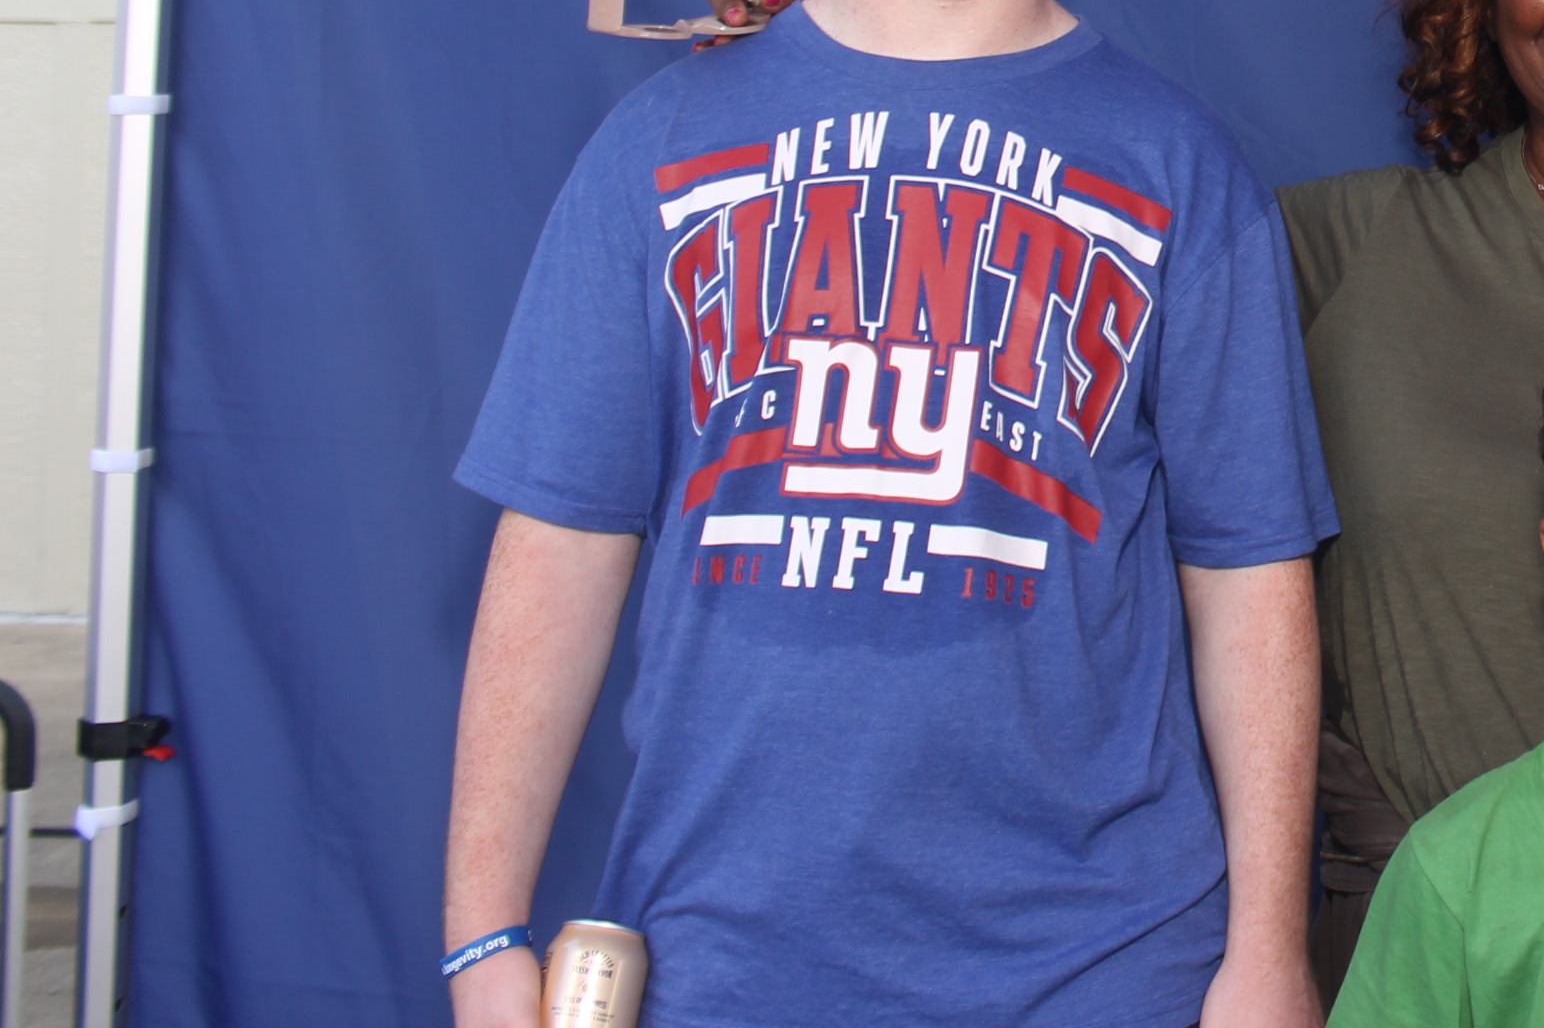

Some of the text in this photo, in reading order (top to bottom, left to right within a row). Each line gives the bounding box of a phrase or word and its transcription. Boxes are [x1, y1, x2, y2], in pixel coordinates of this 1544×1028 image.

[771, 111, 1062, 206] NEW YORK
[665, 175, 1152, 457] GIANTS
[980, 400, 1043, 462] EAST
[692, 554, 1037, 609] INCE 1925
[782, 516, 924, 595] NFL
